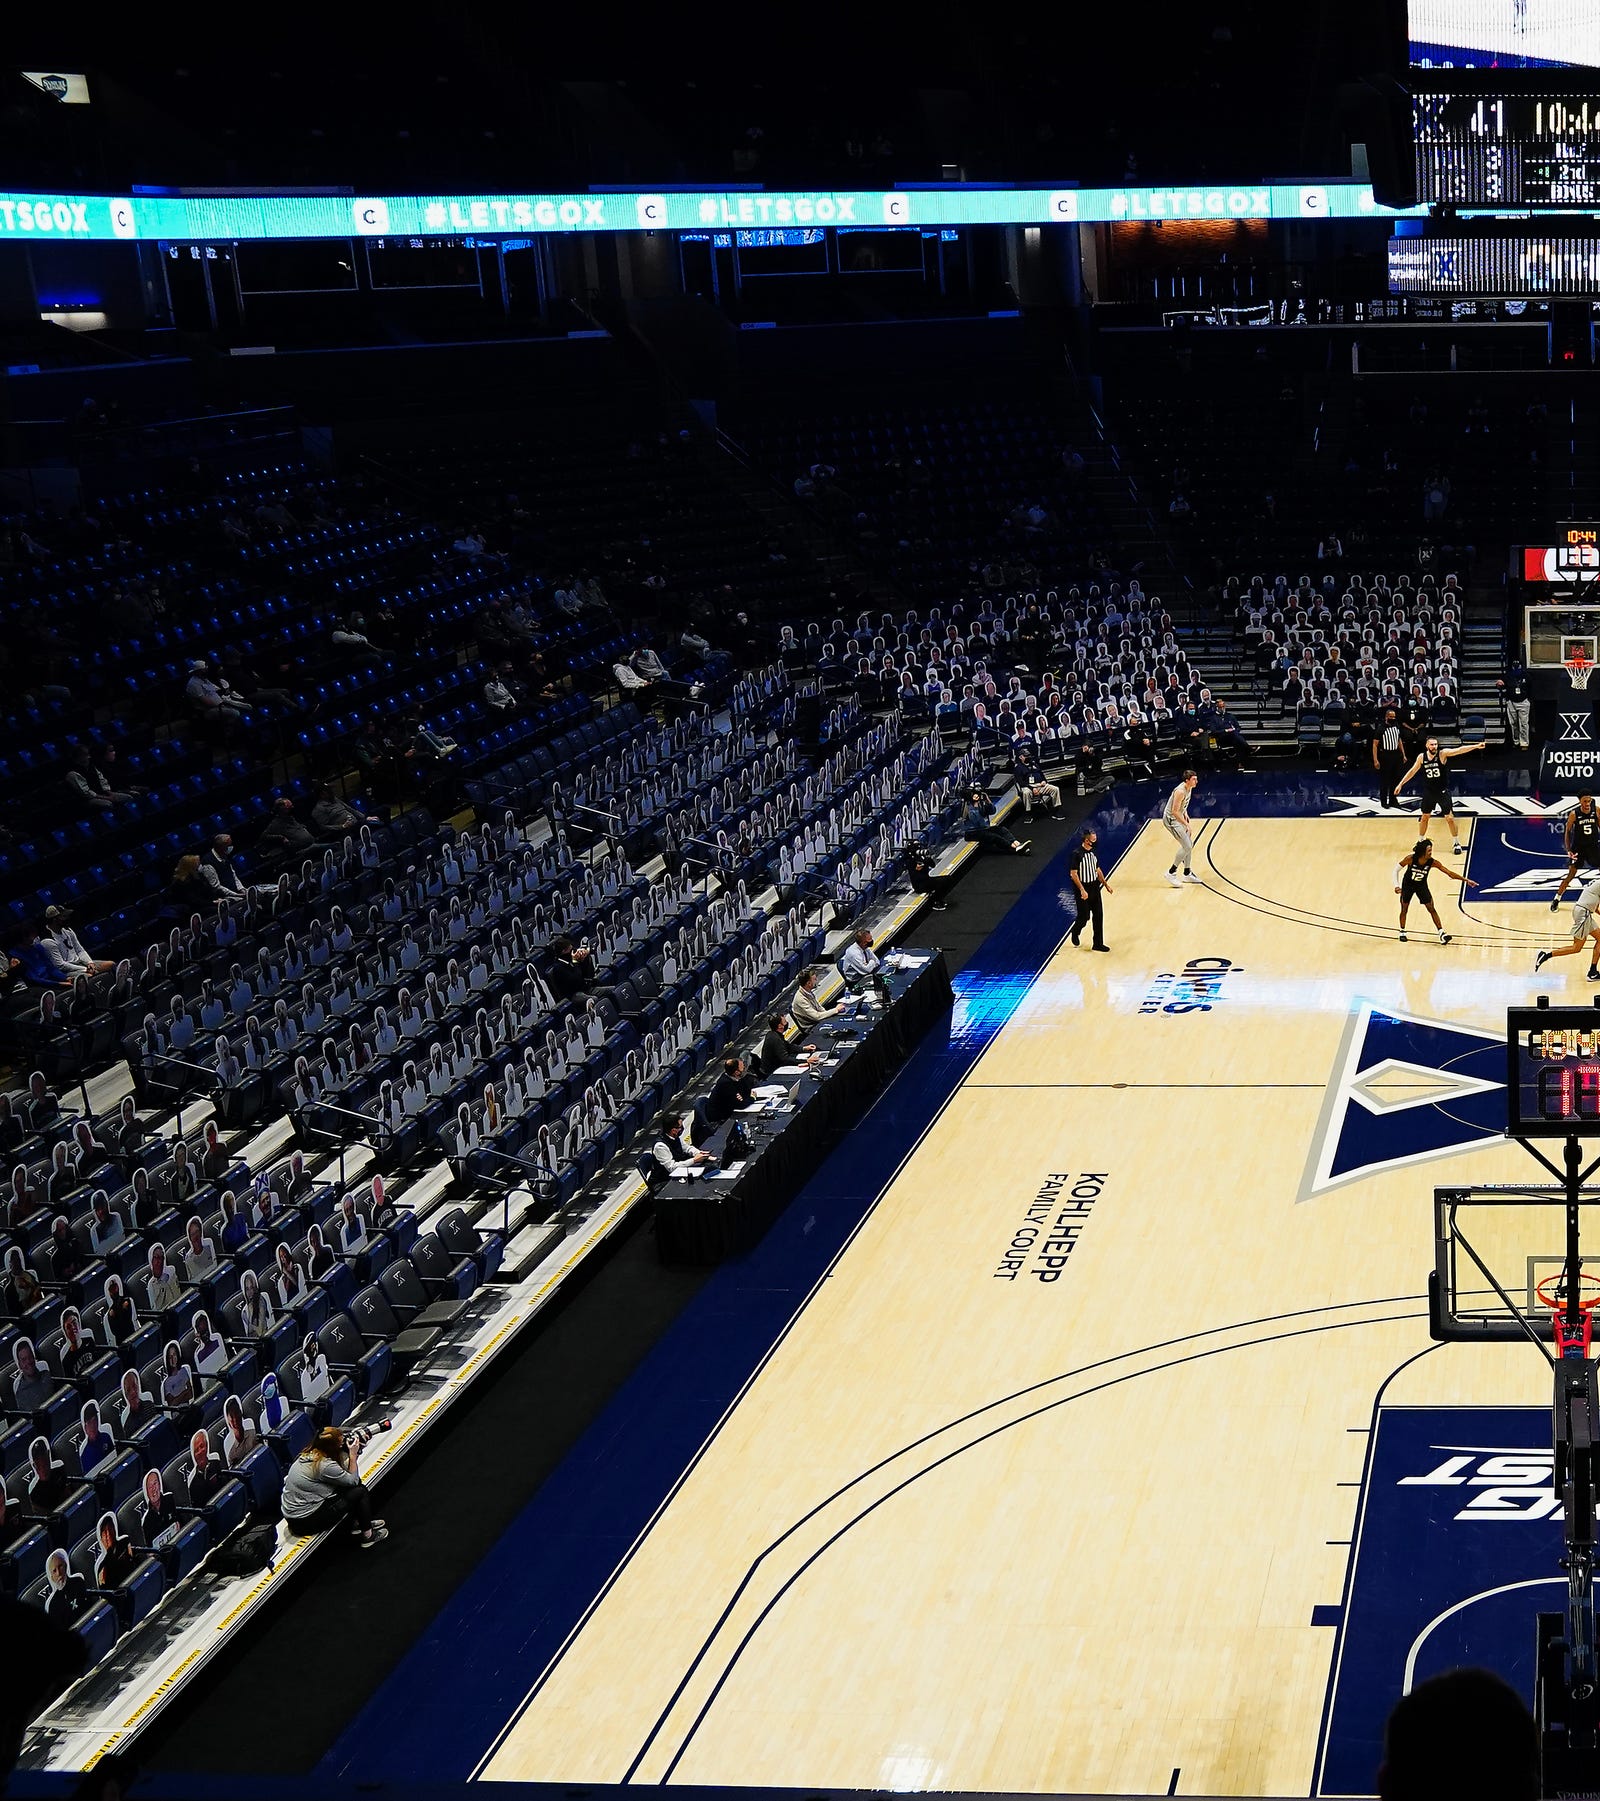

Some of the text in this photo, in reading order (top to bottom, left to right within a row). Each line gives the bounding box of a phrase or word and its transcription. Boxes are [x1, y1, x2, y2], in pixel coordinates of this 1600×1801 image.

[1470, 100, 1503, 136] 41
[700, 198, 856, 224] #LETSGOX
[1110, 190, 1270, 217] #LETSGOX
[425, 201, 605, 229] #LETSGOX
[1567, 530, 1596, 543] 10:44
[1547, 751, 1600, 764] JOSEPH
[1426, 768, 1441, 778] 33
[1555, 765, 1594, 778] AUTO
[1583, 825, 1592, 835] 5
[1411, 871, 1425, 882] 12
[993, 1173, 1069, 1281] FAMILY COURT
[1031, 1173, 1109, 1283] KOHLHEPP
